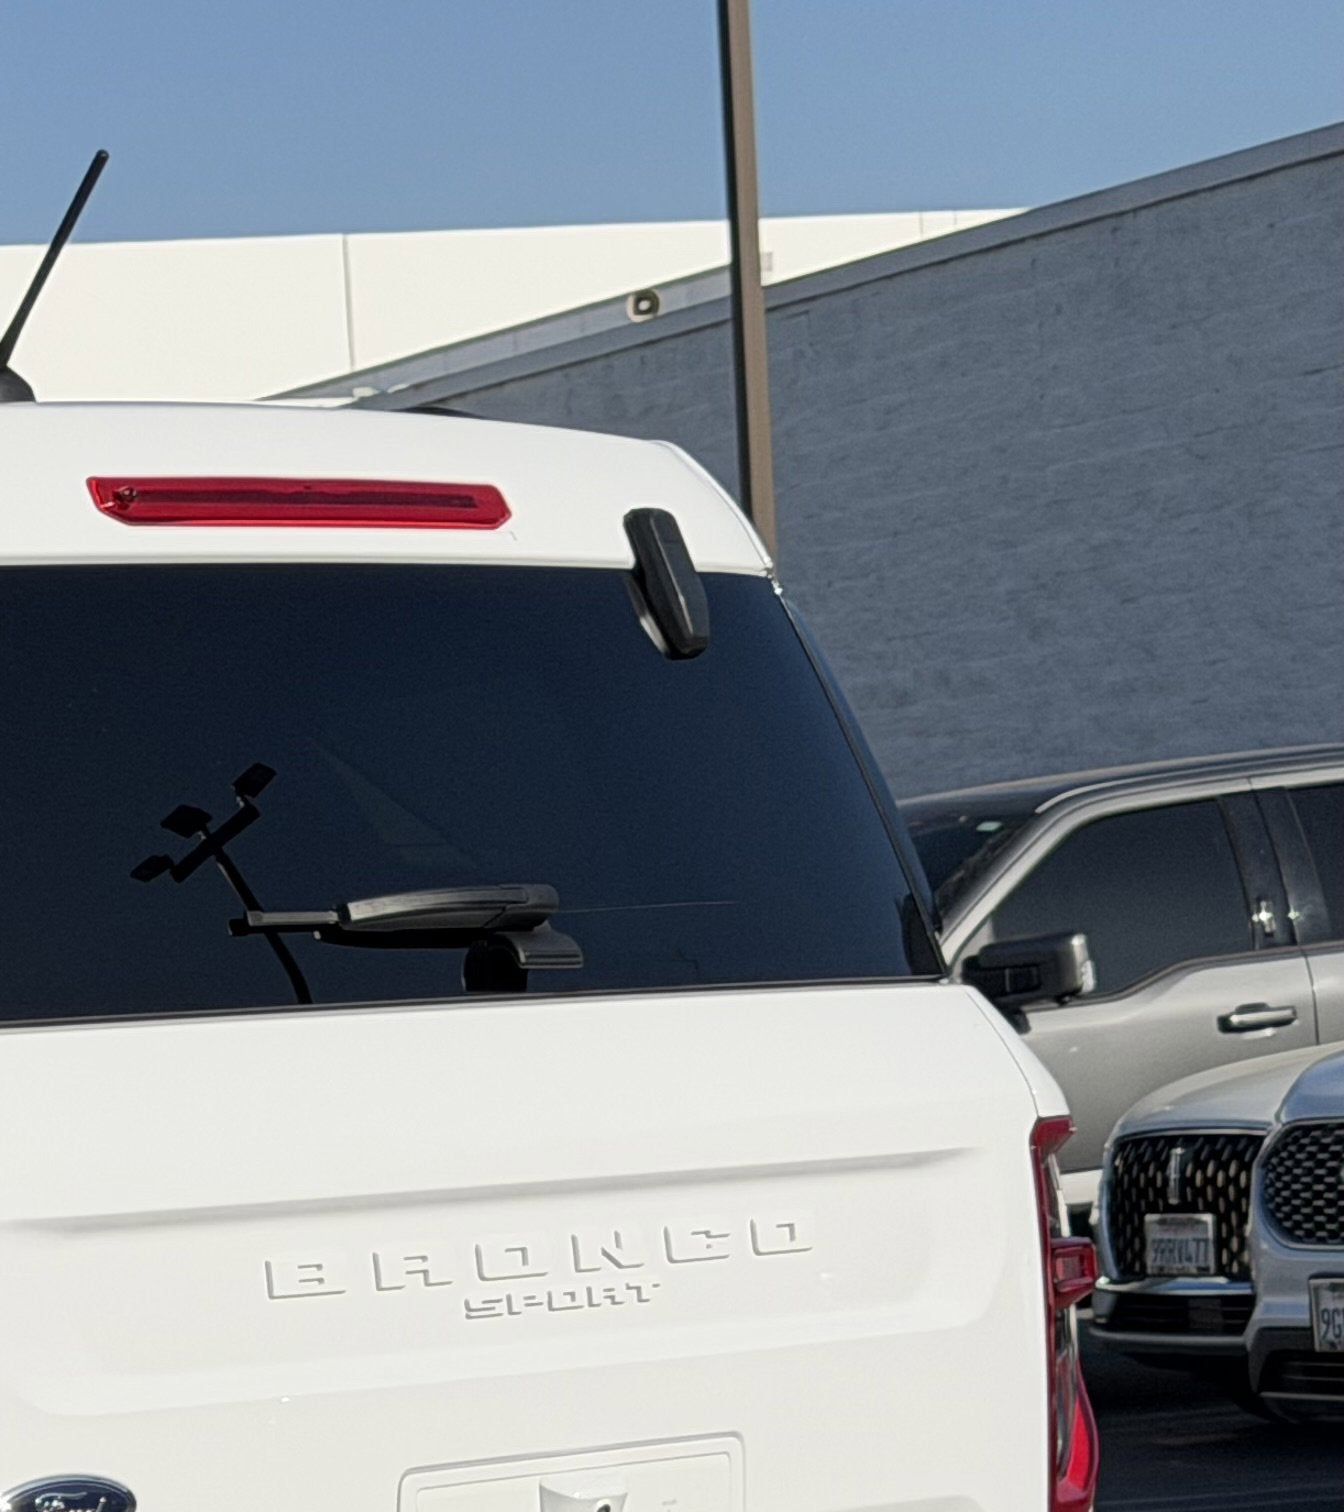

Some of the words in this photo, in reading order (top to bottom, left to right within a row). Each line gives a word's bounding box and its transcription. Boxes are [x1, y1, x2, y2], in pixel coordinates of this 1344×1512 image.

[263, 1216, 815, 1300] BRONCO
[463, 1281, 662, 1320] SPORT
[1321, 1307, 1344, 1341] 9G
